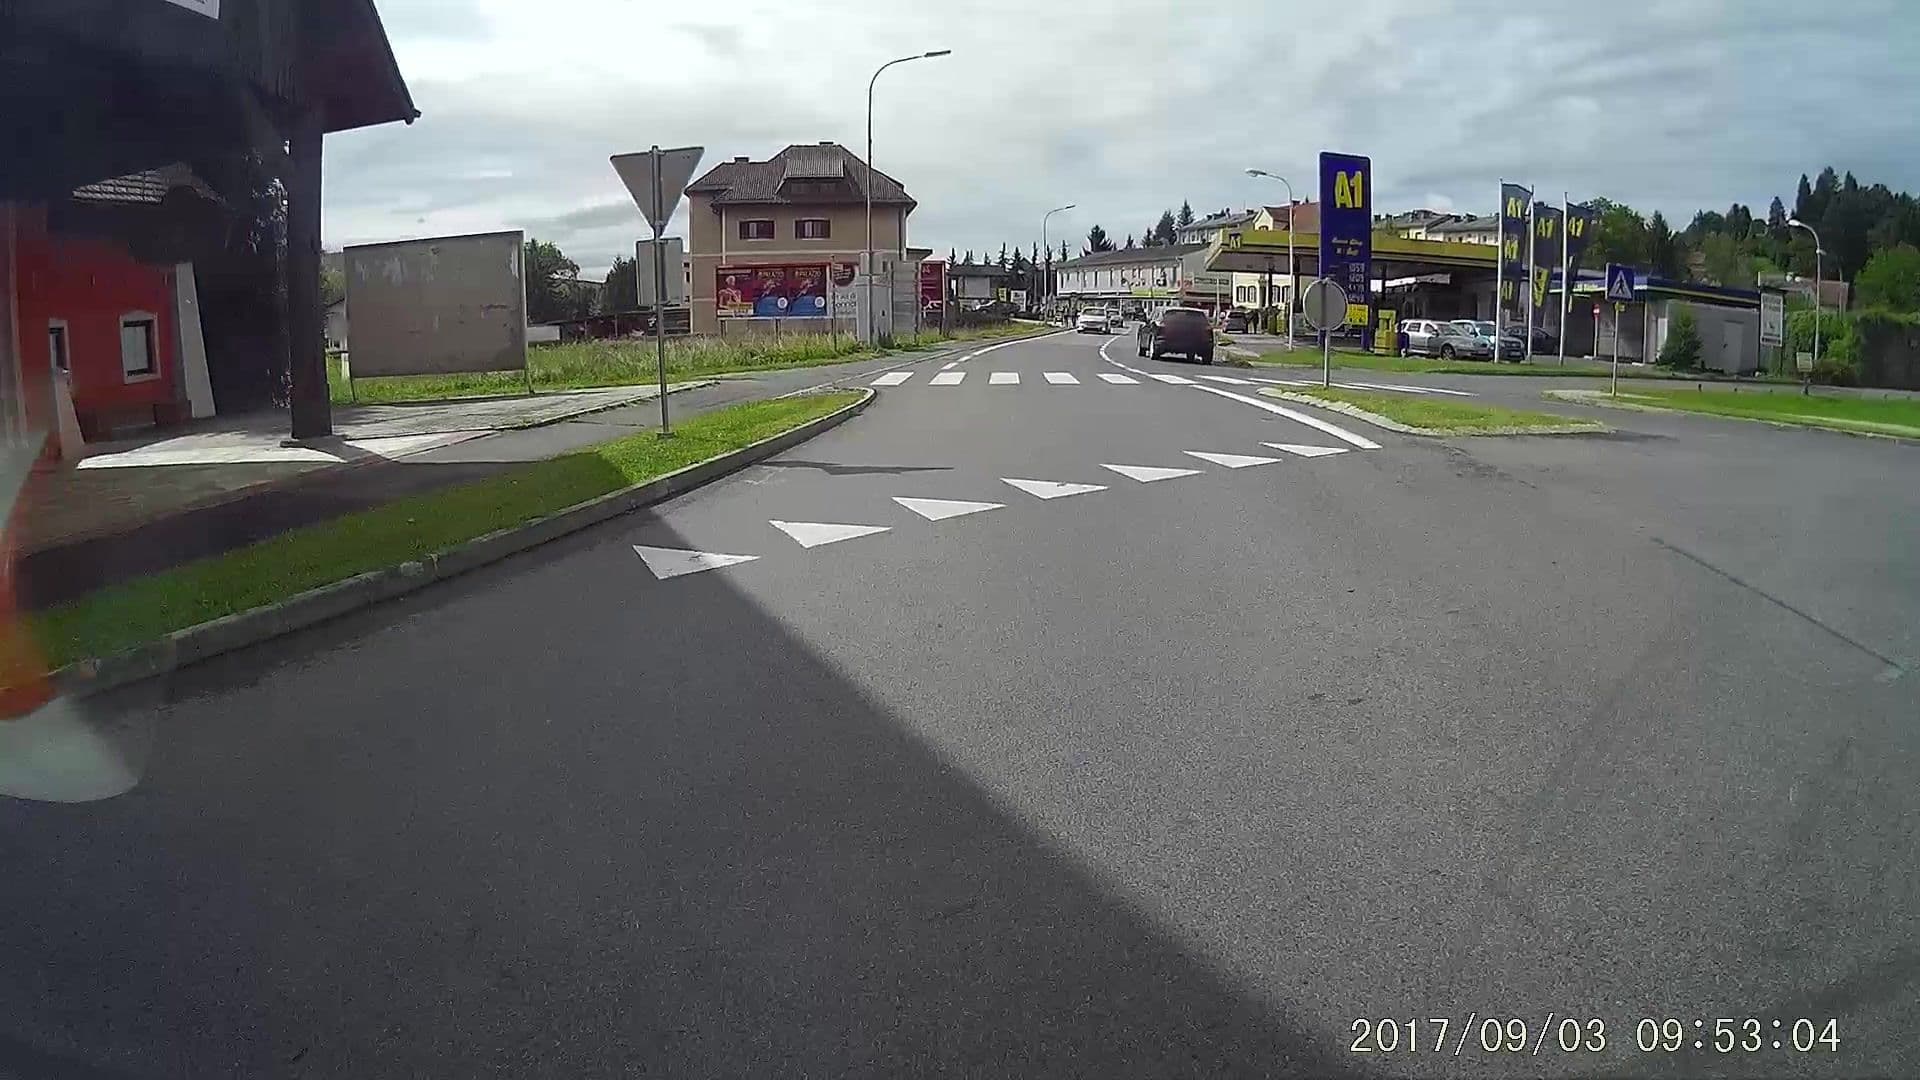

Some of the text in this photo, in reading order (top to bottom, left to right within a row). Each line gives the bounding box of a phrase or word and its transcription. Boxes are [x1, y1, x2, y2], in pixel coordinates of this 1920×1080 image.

[1335, 171, 1363, 208] A1
[1507, 197, 1523, 218] A1
[1536, 218, 1554, 238] A1
[1568, 217, 1584, 236] A1
[1504, 239, 1518, 260] A1
[1500, 280, 1514, 301] A1
